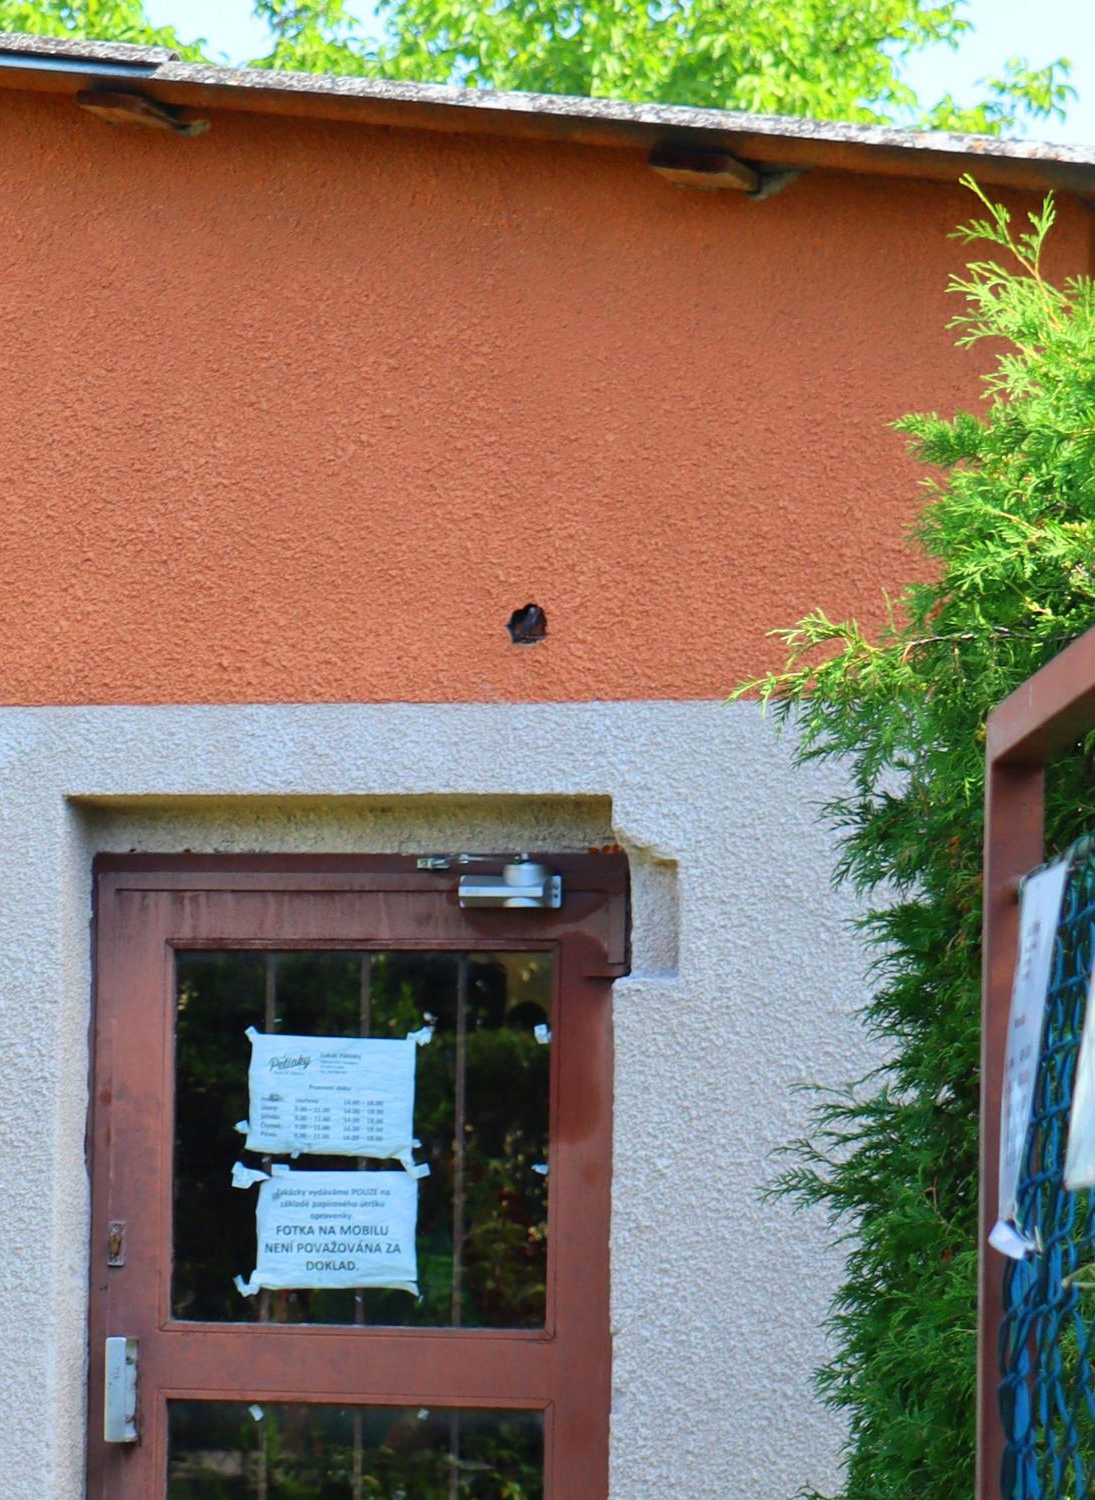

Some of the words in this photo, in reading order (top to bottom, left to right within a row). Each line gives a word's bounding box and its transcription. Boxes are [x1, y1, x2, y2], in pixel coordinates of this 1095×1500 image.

[308, 1188, 349, 1197] vydáváme
[351, 1188, 378, 1196] POUZE
[280, 1199, 310, 1208] základě
[312, 1199, 358, 1209] papírového
[276, 1225, 315, 1236] FOTKA
[319, 1225, 336, 1236] NA
[339, 1225, 389, 1236] MOBILU
[265, 1242, 294, 1254] NENÍ
[297, 1241, 382, 1253] POVAŽOVÁNA
[385, 1243, 402, 1254] ZA
[306, 1260, 360, 1271] DOKLAD.
